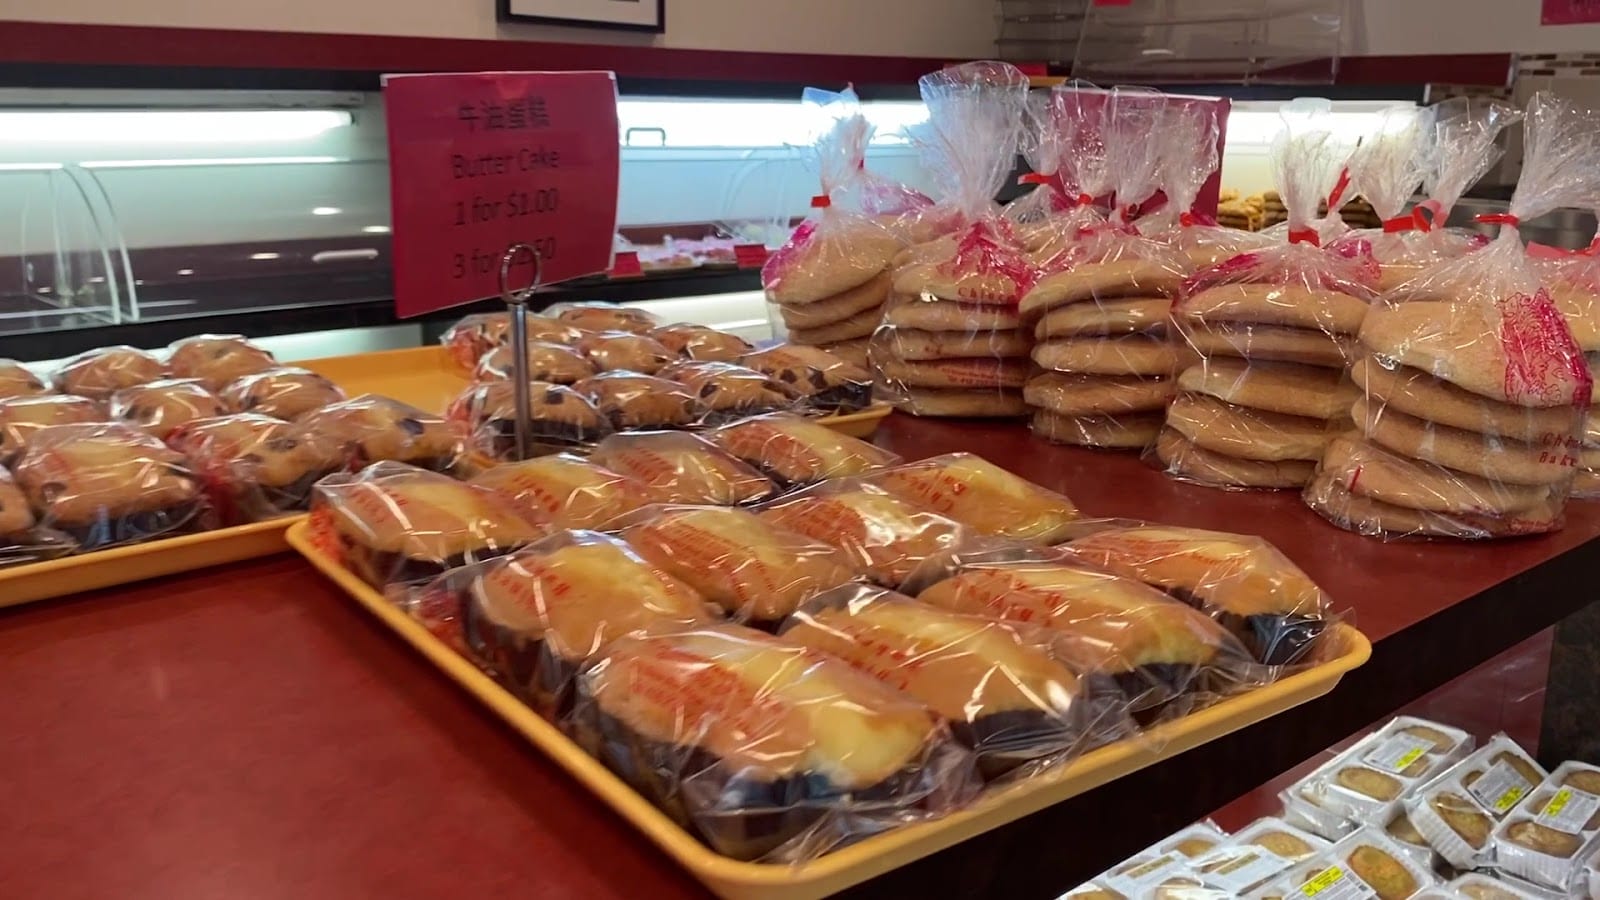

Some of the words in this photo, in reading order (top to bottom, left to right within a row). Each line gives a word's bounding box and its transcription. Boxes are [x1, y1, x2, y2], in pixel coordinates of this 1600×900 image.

[452, 153, 513, 180] Butter
[517, 147, 560, 172] Cake
[454, 200, 466, 226] 1
[471, 195, 502, 223] for
[506, 187, 559, 218] $1.00
[453, 253, 465, 279] 3
[471, 248, 500, 275] for
